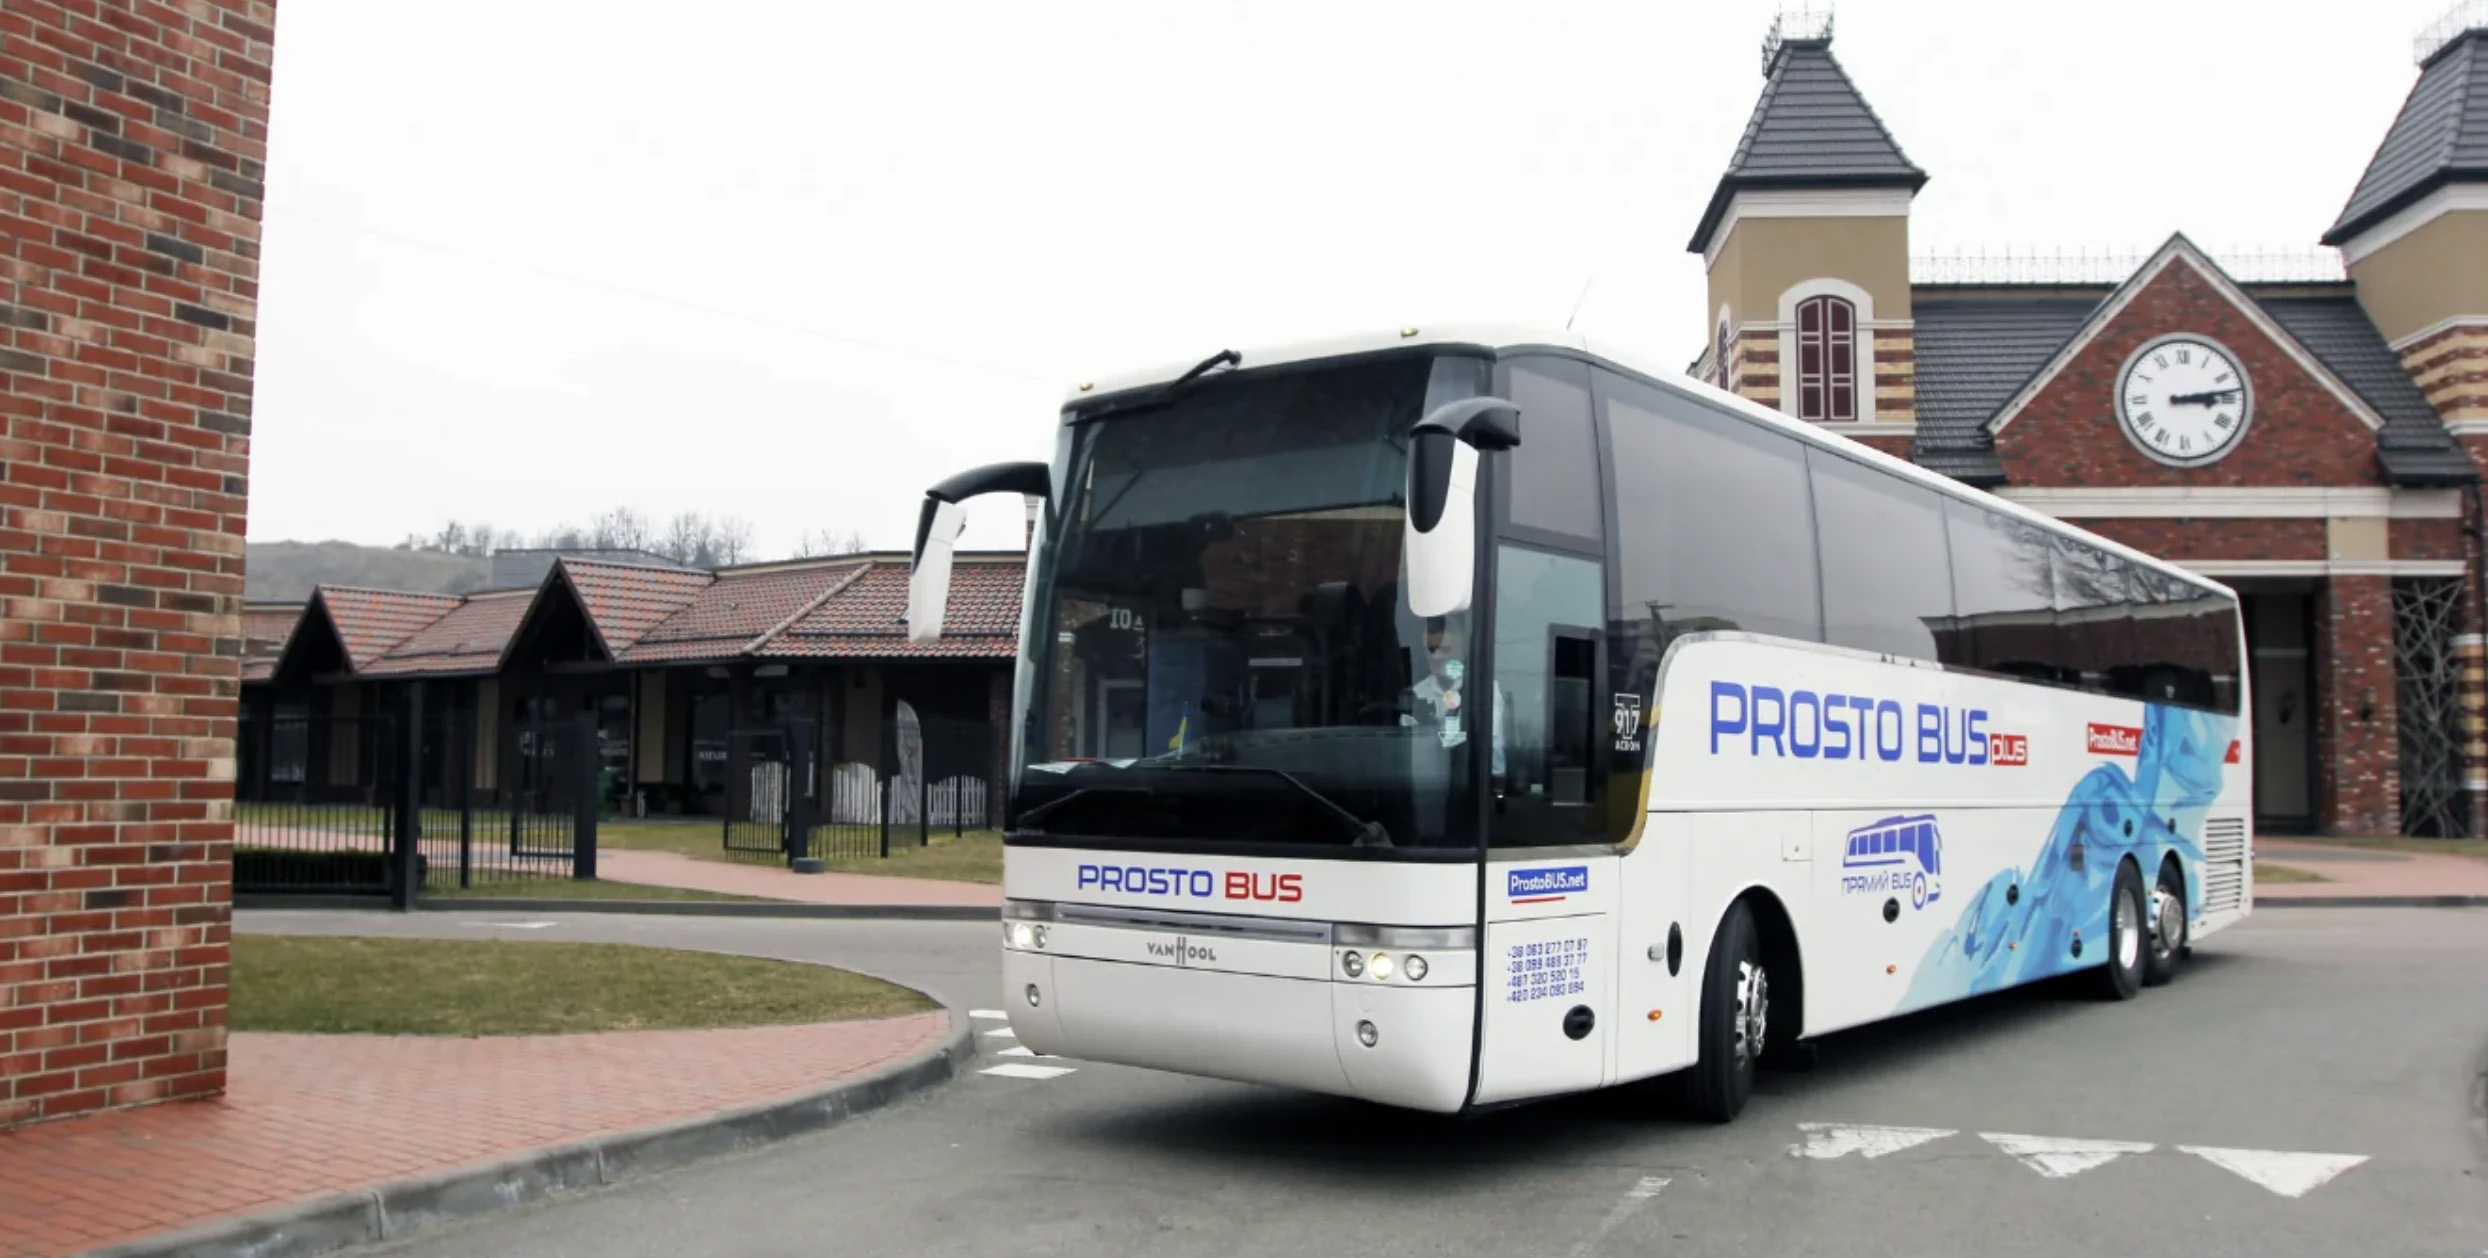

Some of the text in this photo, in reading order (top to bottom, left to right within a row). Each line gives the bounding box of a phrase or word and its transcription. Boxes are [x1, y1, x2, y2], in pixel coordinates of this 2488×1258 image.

[1710, 680, 2027, 766] PROSTO BUS plus
[1078, 865, 1303, 902] PROSTO BUS
[1511, 872, 1585, 892] ProstoBUS.net
